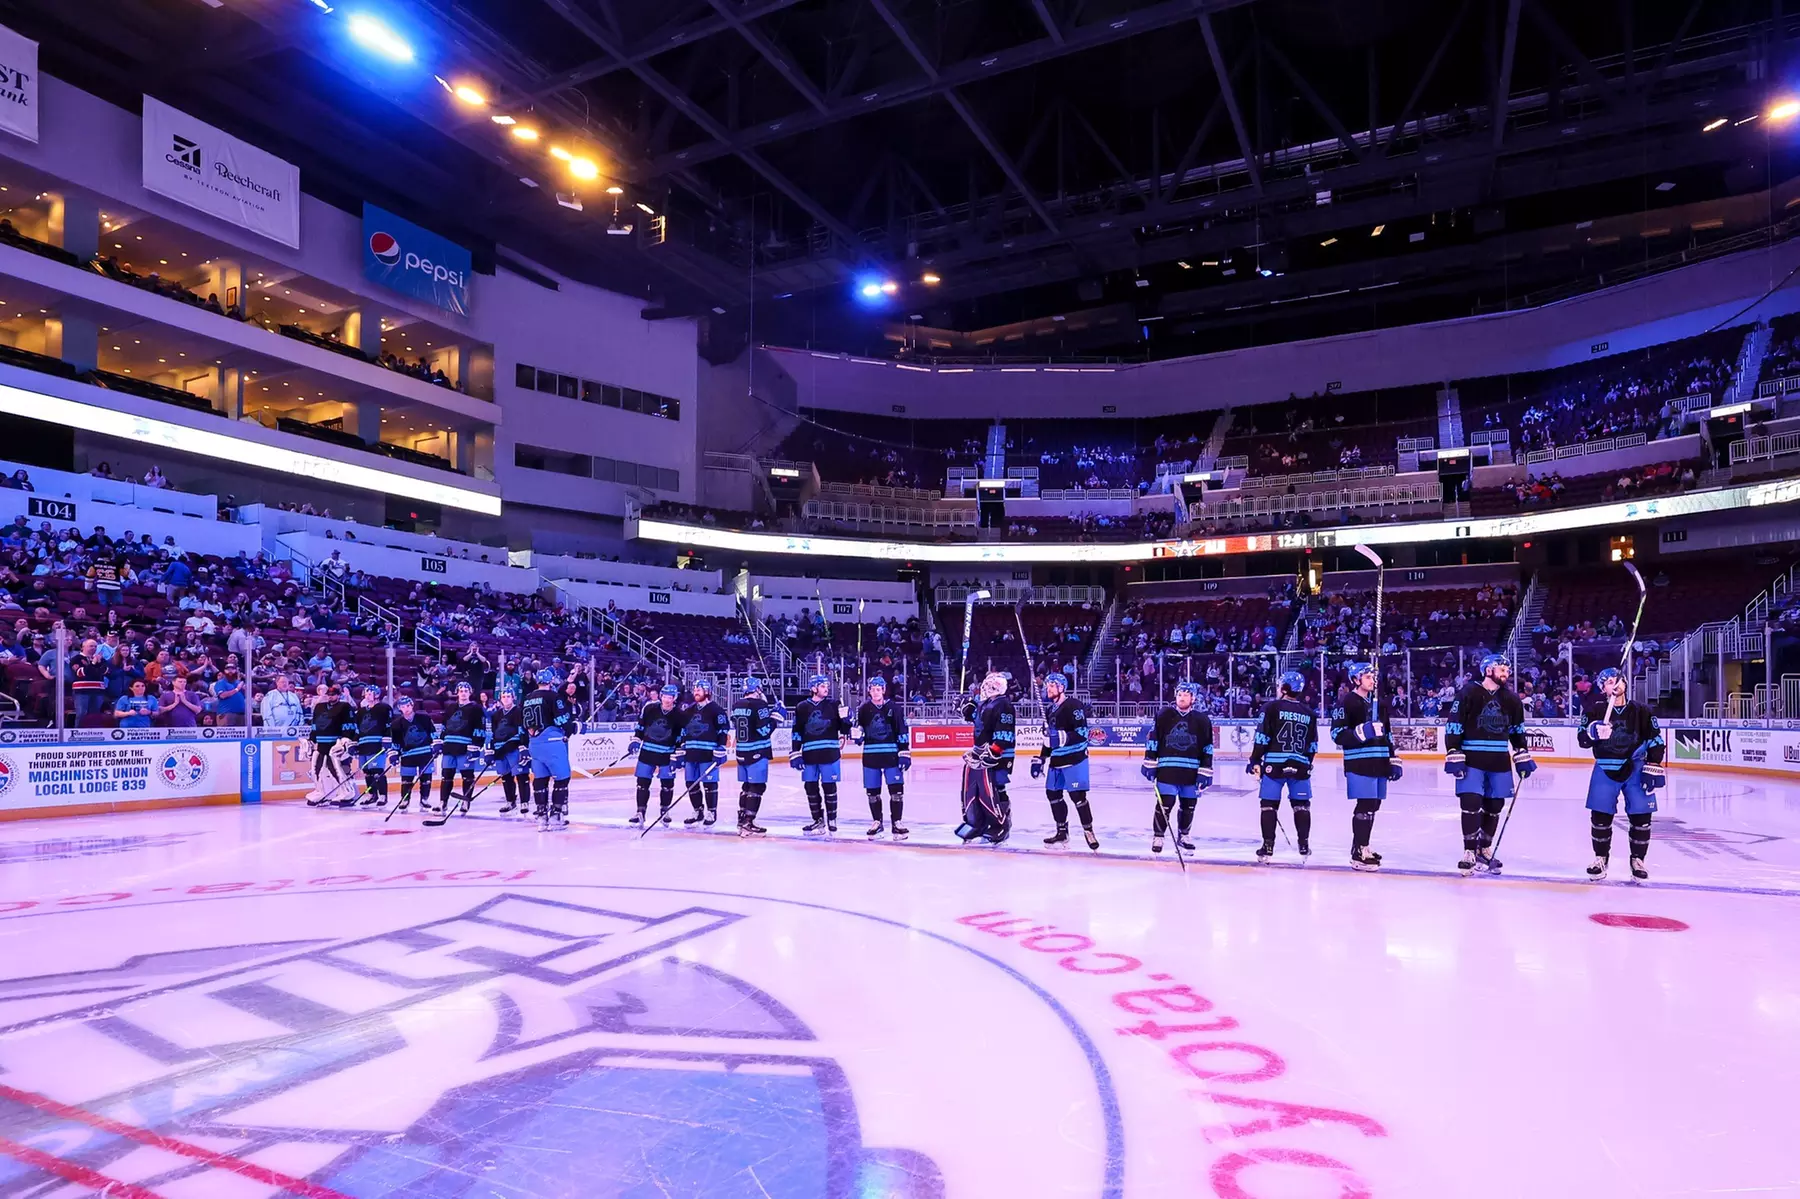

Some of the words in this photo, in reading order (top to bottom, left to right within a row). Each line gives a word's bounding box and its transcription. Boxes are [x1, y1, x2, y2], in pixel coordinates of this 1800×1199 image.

[165, 154, 201, 175] Cessna
[214, 162, 281, 202] Beechcraft
[405, 252, 463, 288] pepsi
[35, 500, 72, 519] 104
[1667, 531, 1683, 541] 111
[425, 559, 444, 572] 105
[1408, 572, 1424, 580] 110
[1203, 583, 1217, 591] 109
[651, 592, 669, 604] 106
[836, 604, 851, 614] 107
[725, 677, 781, 686] ESOMS
[522, 705, 545, 730] 21
[1279, 711, 1311, 725] PRESTON
[1332, 708, 1345, 720] 44
[1277, 720, 1309, 755] 43
[1533, 736, 1553, 748] PEAKS
[1702, 730, 1732, 753] ECK
[35, 752, 64, 760] PROUD
[66, 751, 117, 759] SUPPORTERS
[119, 750, 129, 758] OF
[131, 749, 144, 757] THE
[1702, 754, 1732, 762] SERVICES
[28, 761, 67, 769] THUNDER
[69, 760, 86, 768] AND
[89, 759, 103, 767] THE
[105, 757, 152, 766] COMMUNITY
[28, 768, 108, 783] MACHINISTS
[113, 767, 148, 779] UNION
[35, 783, 75, 796] LOCAL
[79, 781, 118, 793] LODGE
[122, 779, 146, 791] 839
